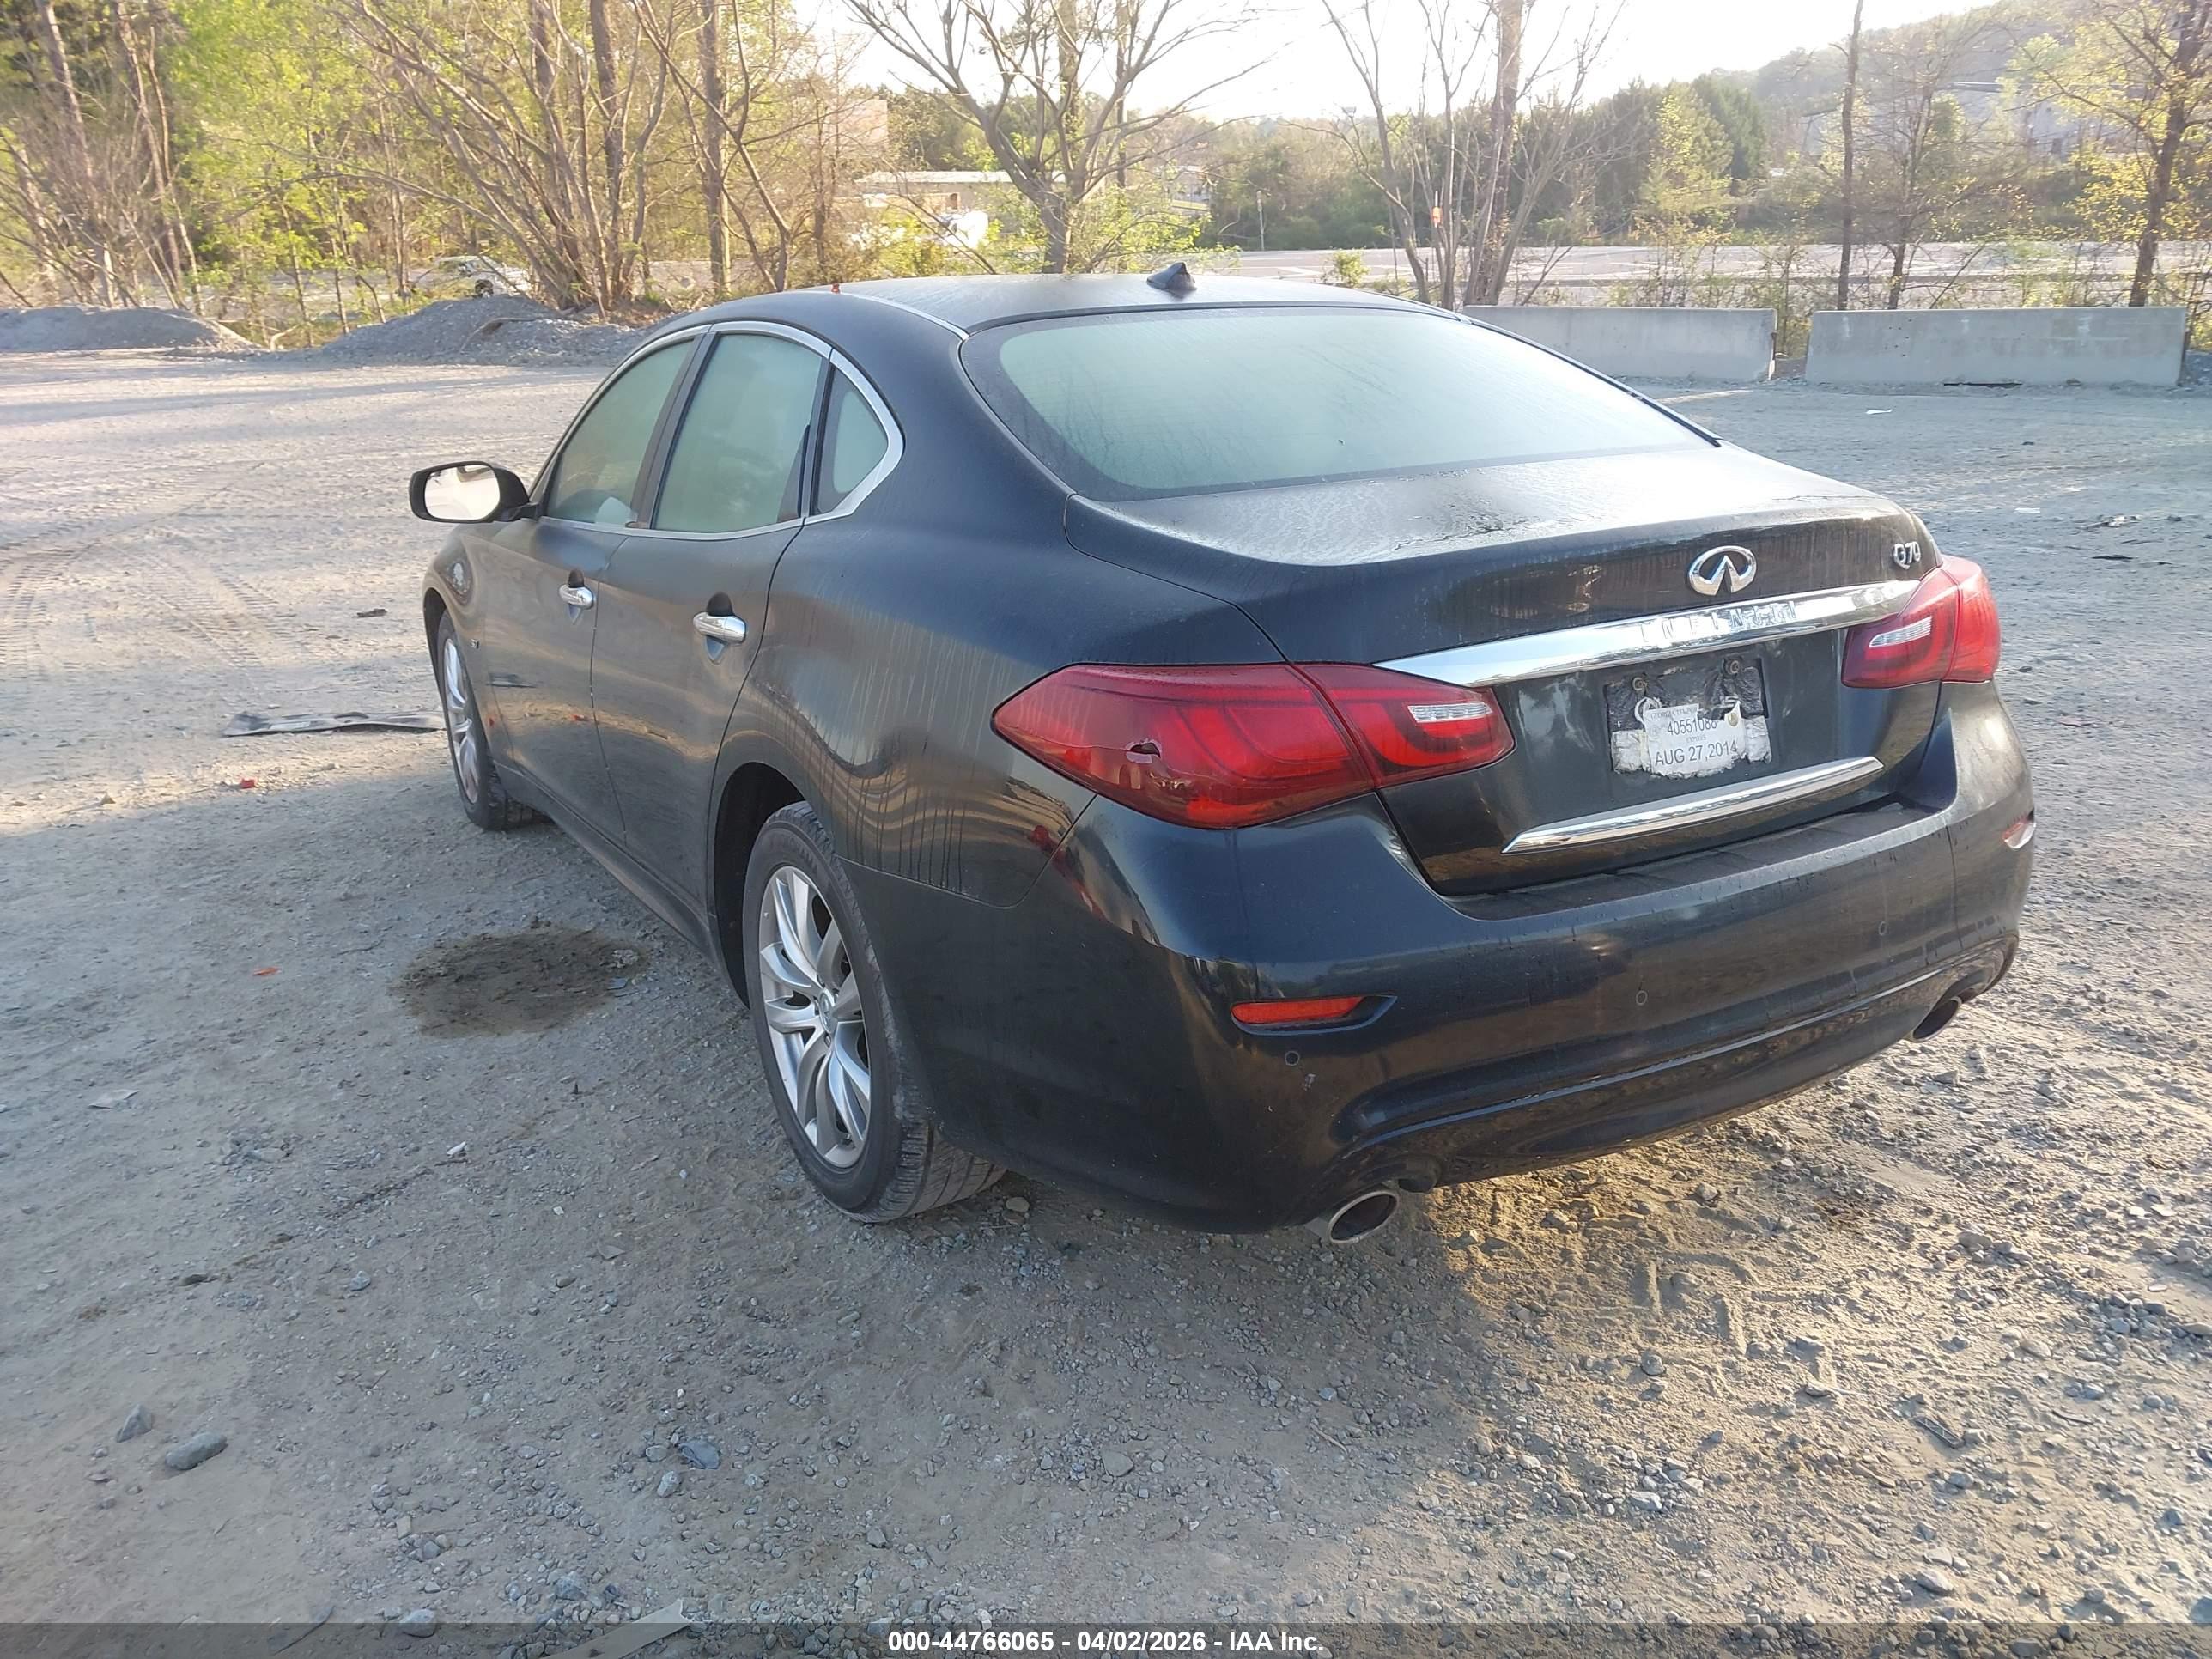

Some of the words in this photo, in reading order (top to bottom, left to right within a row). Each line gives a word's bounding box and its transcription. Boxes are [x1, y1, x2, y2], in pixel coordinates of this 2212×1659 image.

[1893, 541, 1921, 570] Q70
[1655, 748, 1685, 766] AUG
[1688, 740, 1738, 762] 27,2014
